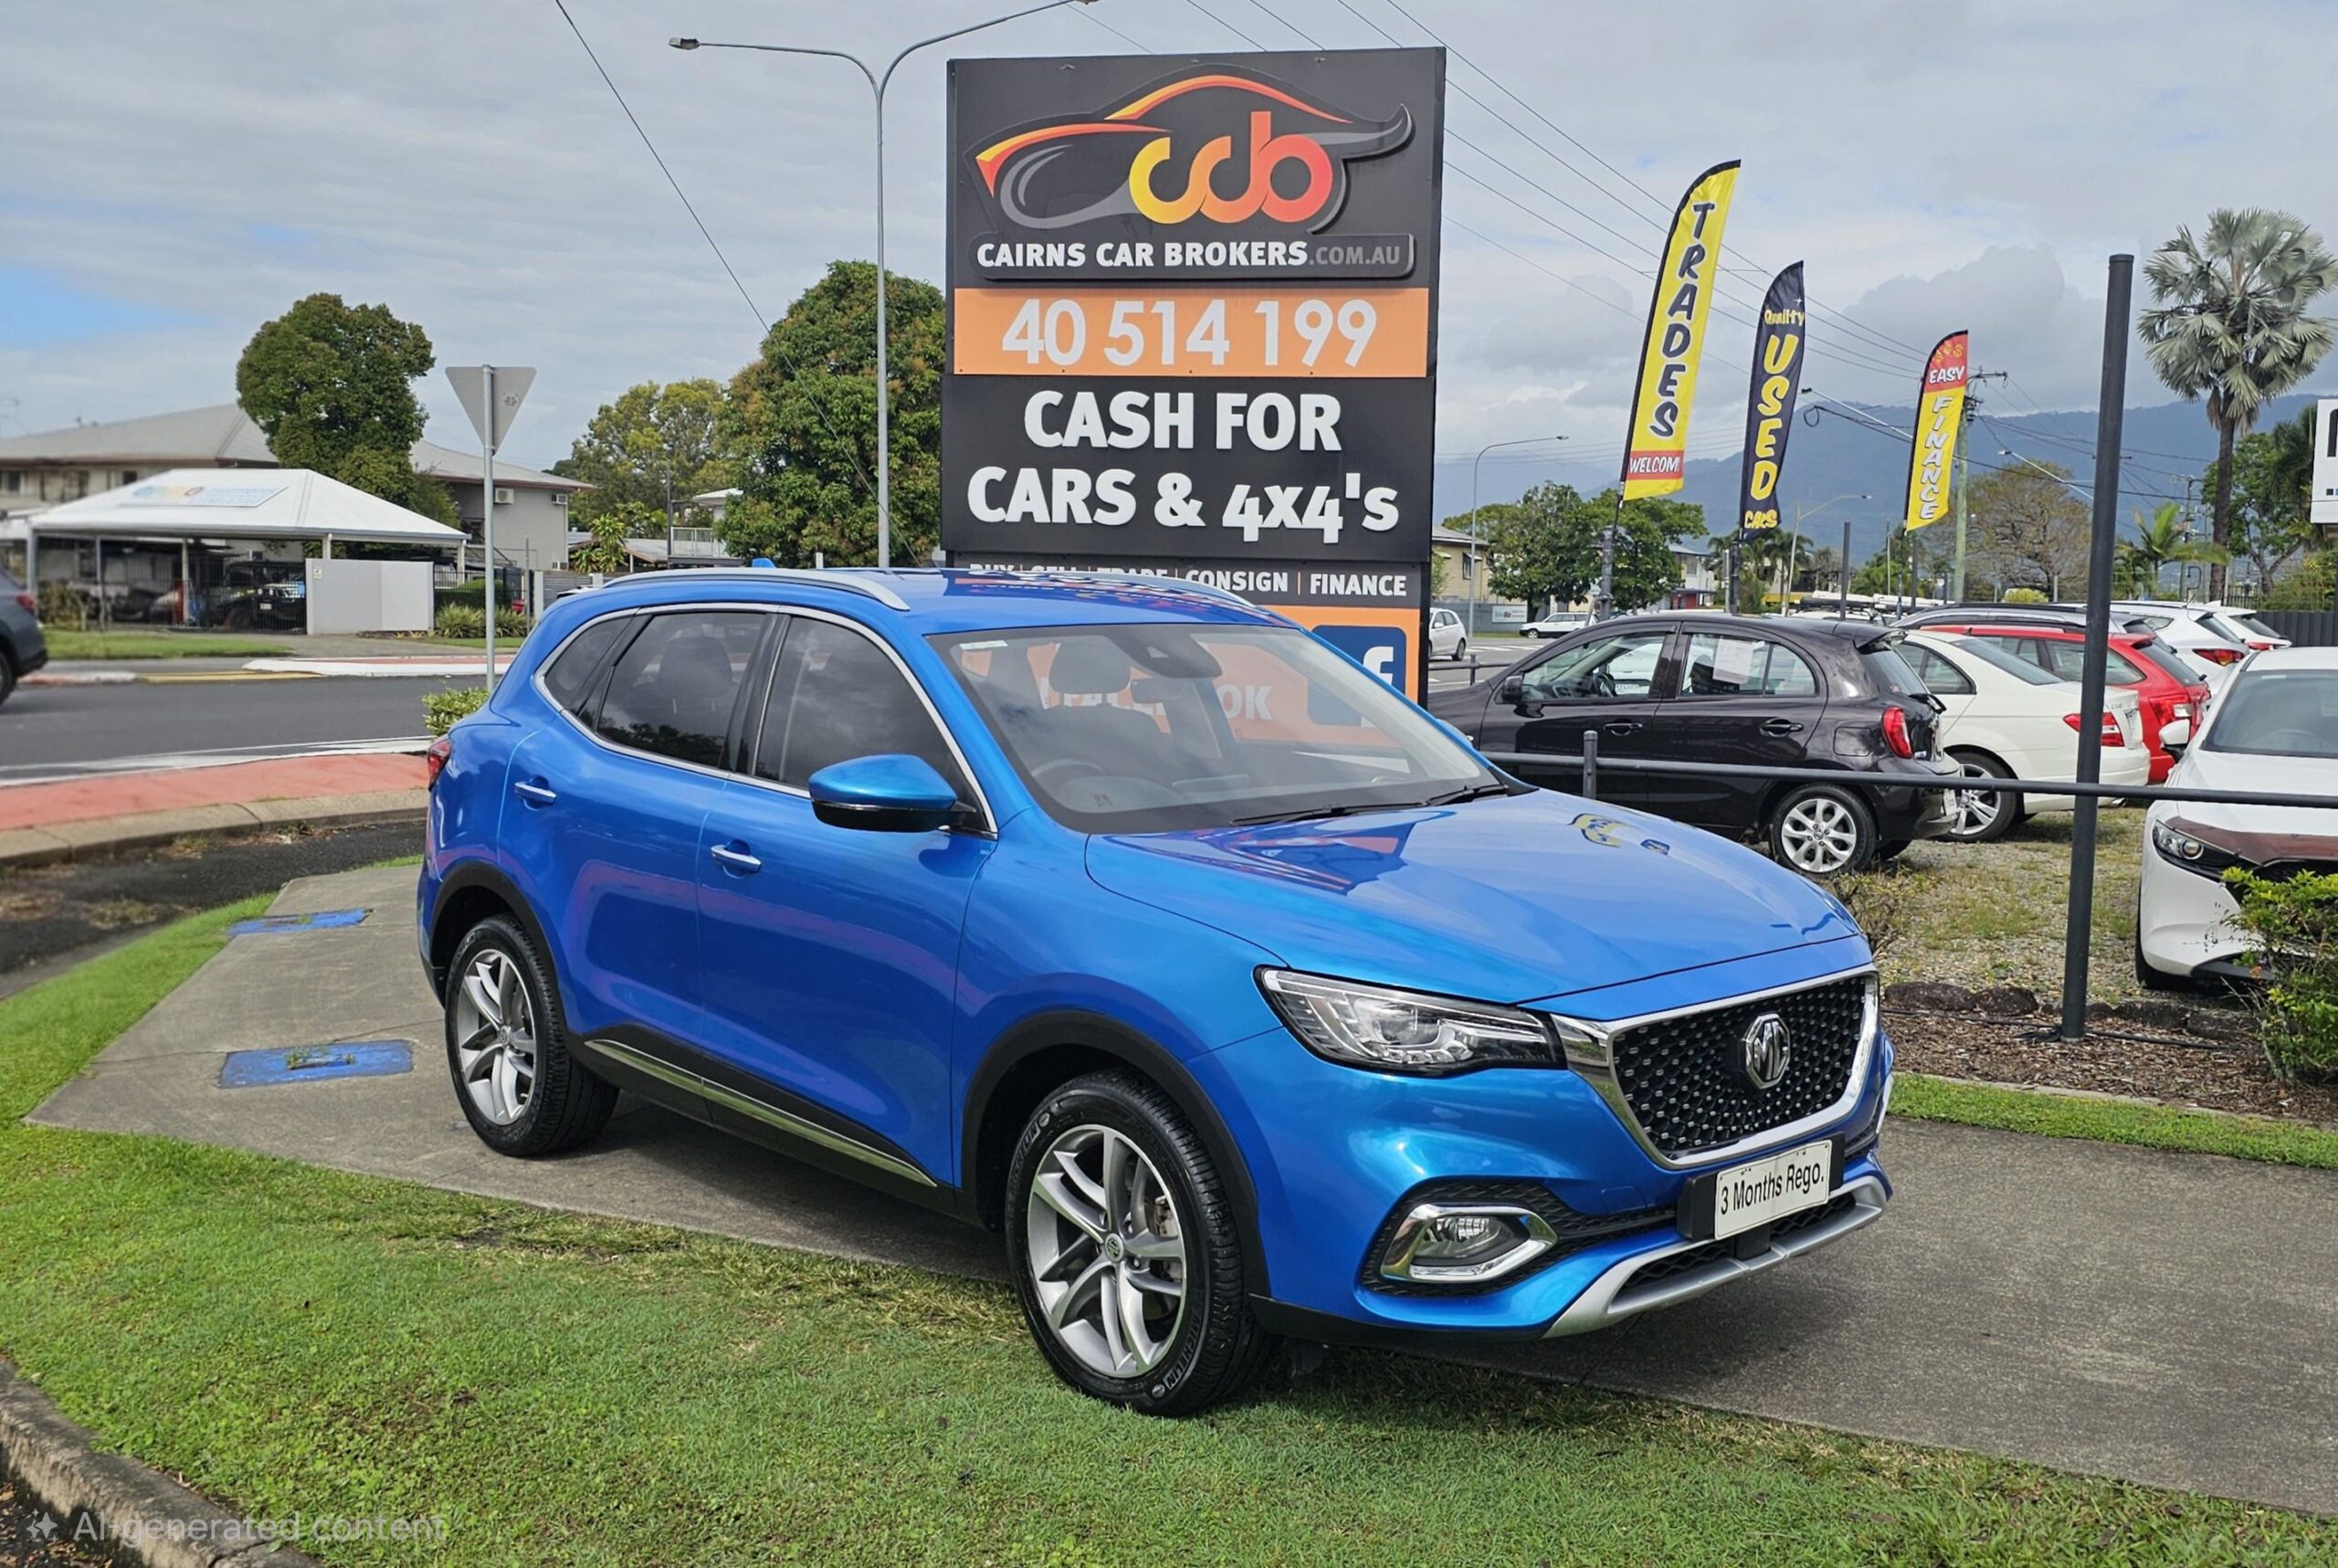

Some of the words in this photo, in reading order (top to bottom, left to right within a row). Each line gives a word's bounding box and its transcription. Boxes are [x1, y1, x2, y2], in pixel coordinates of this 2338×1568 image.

[976, 243, 1086, 268] CAIRNS
[1095, 243, 1154, 268] CAR
[1002, 299, 1087, 366] 40
[1102, 299, 1230, 366] 514
[1253, 299, 1377, 367] 199
[1649, 202, 1716, 438] TRADES
[1929, 365, 1965, 384] EASY
[1024, 390, 1195, 449] CASH
[1216, 392, 1343, 452] FOR
[1750, 333, 1799, 501] USED
[1629, 456, 1680, 474] WELCOM
[1919, 395, 1954, 521] FINANCE
[967, 466, 1137, 526] CARS
[1153, 472, 1206, 528] &
[1185, 569, 1289, 593] CONSIGN
[1310, 574, 1407, 596] FINANCE
[1720, 1185, 1729, 1215] 3
[1733, 1175, 1782, 1211] Months
[1785, 1161, 1825, 1194] Rego.
